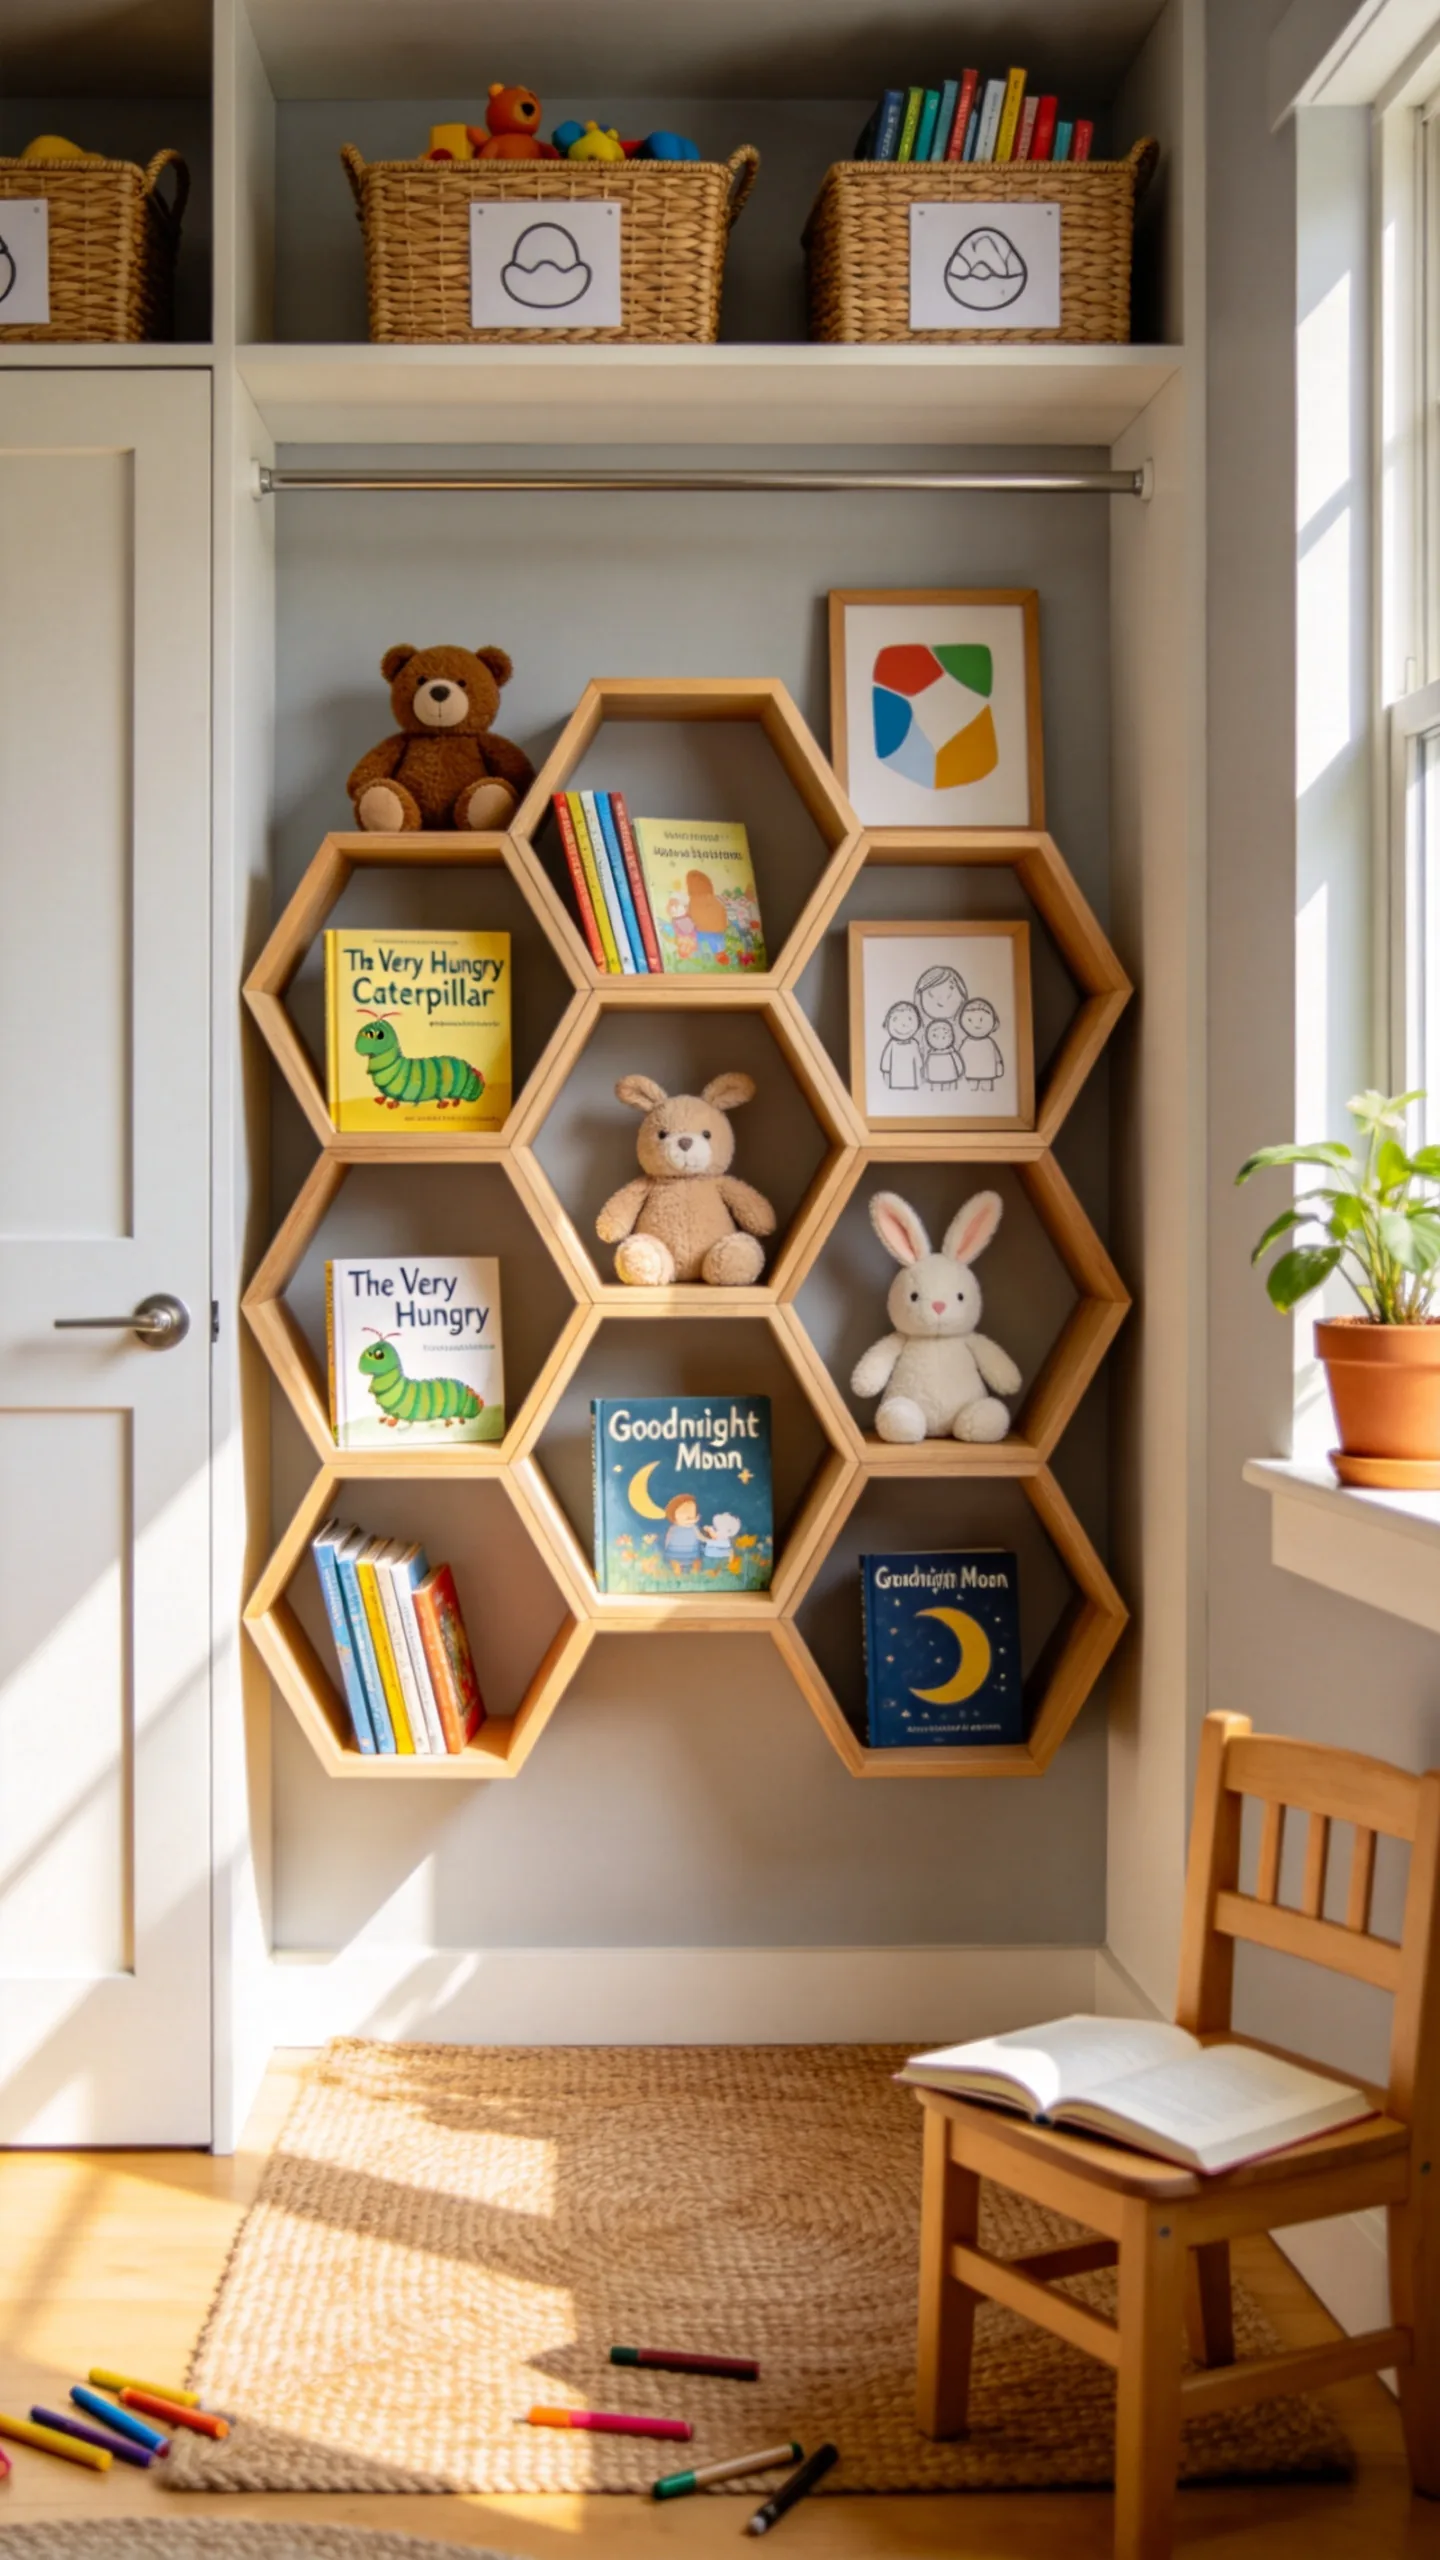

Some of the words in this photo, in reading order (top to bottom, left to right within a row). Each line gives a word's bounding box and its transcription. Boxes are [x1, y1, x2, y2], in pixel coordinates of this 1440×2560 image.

[378, 948, 424, 980] Very
[431, 950, 504, 982] Hungry
[353, 977, 495, 1015] Caterpillar
[348, 1269, 394, 1297] The
[400, 1267, 457, 1302] Very
[395, 1300, 489, 1336] Hungry
